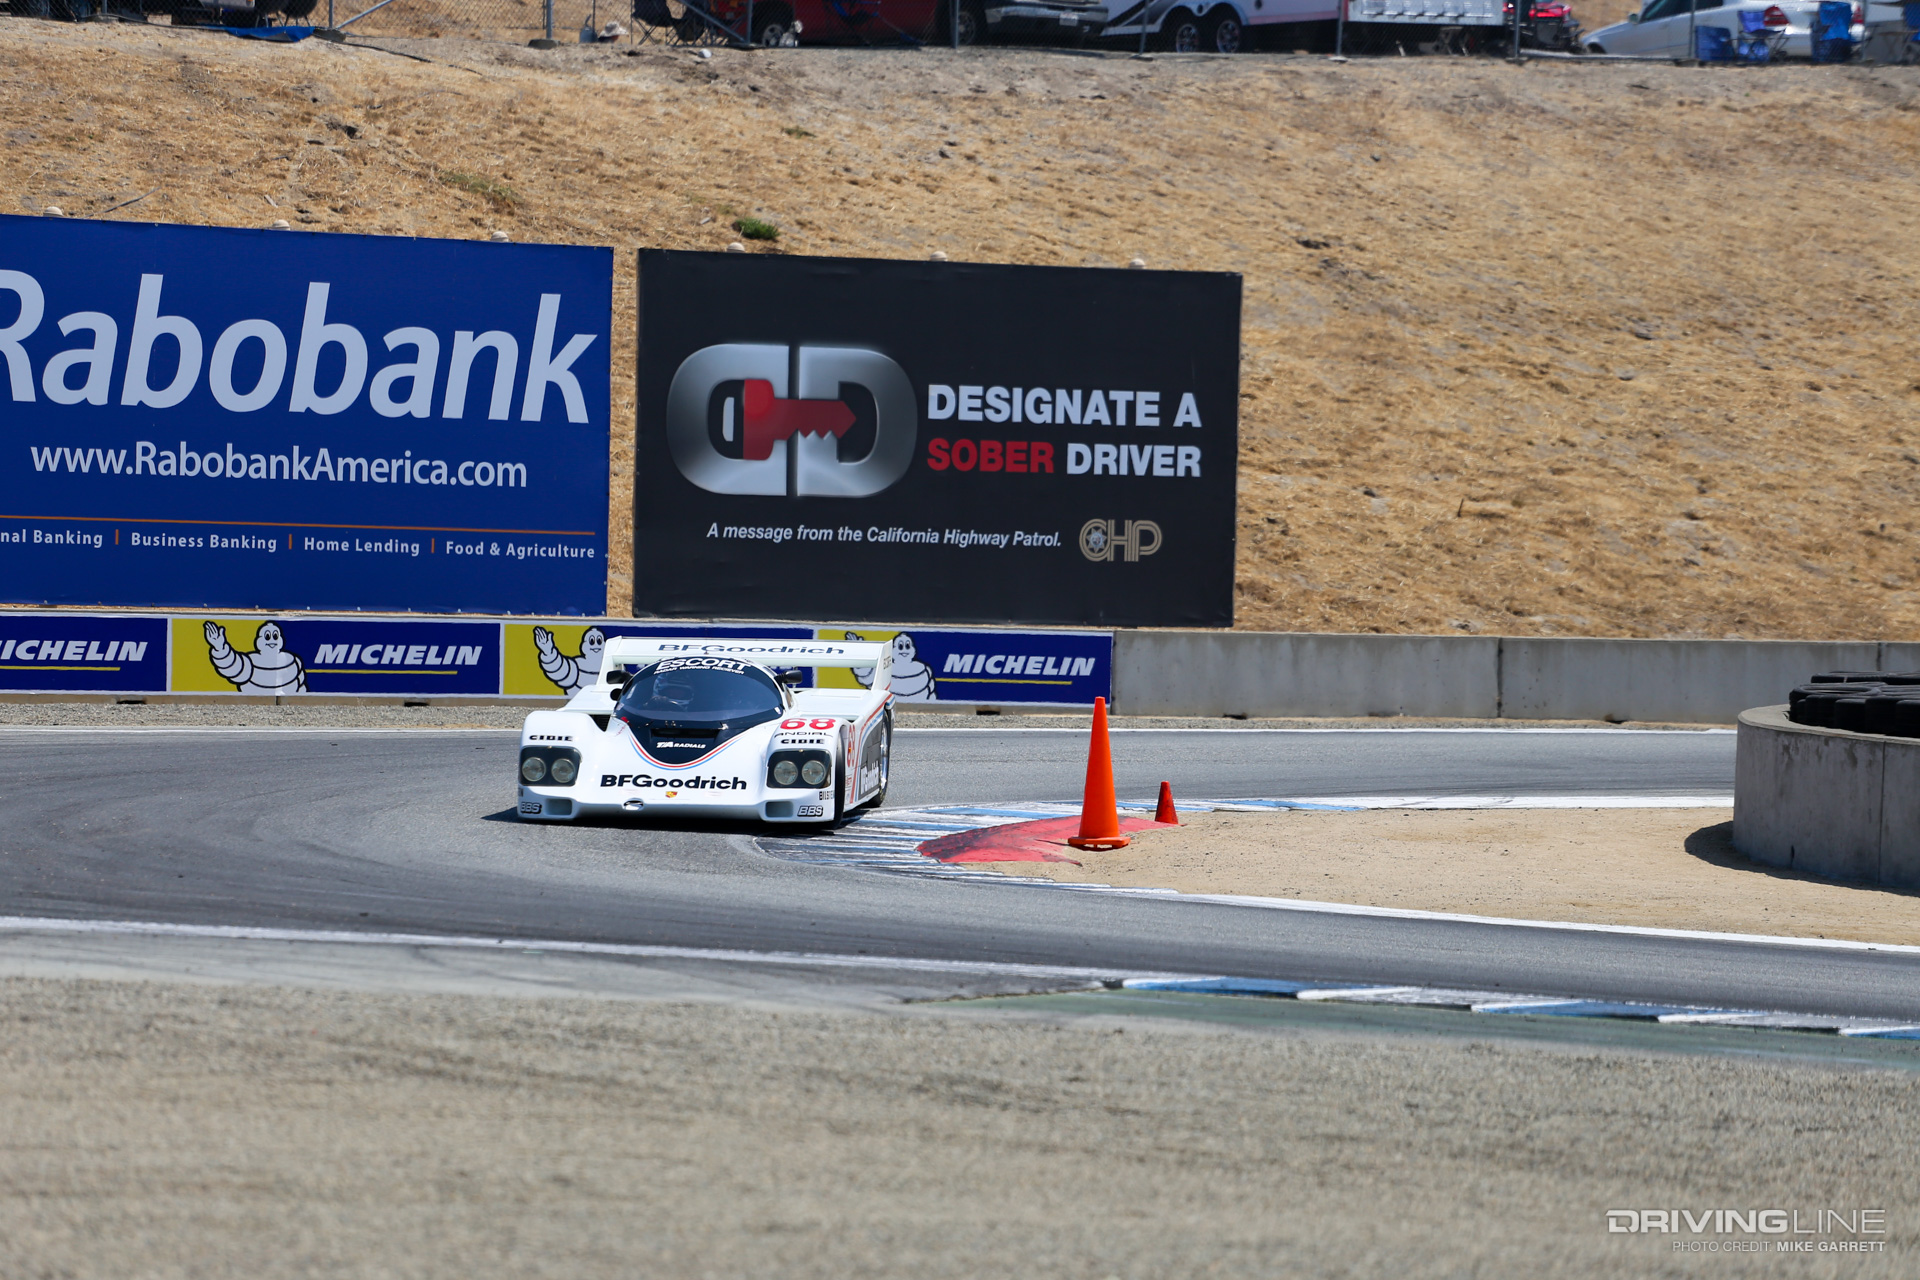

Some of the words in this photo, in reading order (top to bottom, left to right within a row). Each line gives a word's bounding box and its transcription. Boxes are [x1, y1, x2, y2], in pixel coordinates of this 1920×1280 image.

[928, 384, 1160, 426] DESIGNATE
[1173, 393, 1202, 427] A
[30, 440, 527, 488] www.RabobankAmerica.com
[927, 438, 1054, 473] SOBER
[1067, 443, 1201, 477] DRIVER
[33, 529, 104, 548] Banking
[131, 532, 204, 548] Business
[209, 534, 278, 552] Banking
[706, 522, 719, 538] A
[723, 525, 793, 543] message
[796, 525, 833, 541] from
[837, 526, 863, 542] the
[867, 526, 939, 544] California
[943, 529, 1010, 548] Highway
[1012, 531, 1062, 547] Patrol.
[1078, 518, 1163, 562] CHP
[304, 537, 350, 552] Home
[355, 538, 420, 557] Lending
[446, 541, 484, 555] Food
[489, 542, 501, 556] &
[506, 542, 595, 560] Agriculture
[0, 639, 148, 662] ICHELIN
[314, 644, 482, 666] MICHELIN
[658, 644, 845, 656] BFGoodrich
[656, 658, 752, 672] ESCORT
[943, 653, 1096, 677] MICHELIN
[779, 717, 836, 730] 68
[600, 773, 748, 790] BFGoodrich
[797, 805, 824, 818] BBS
